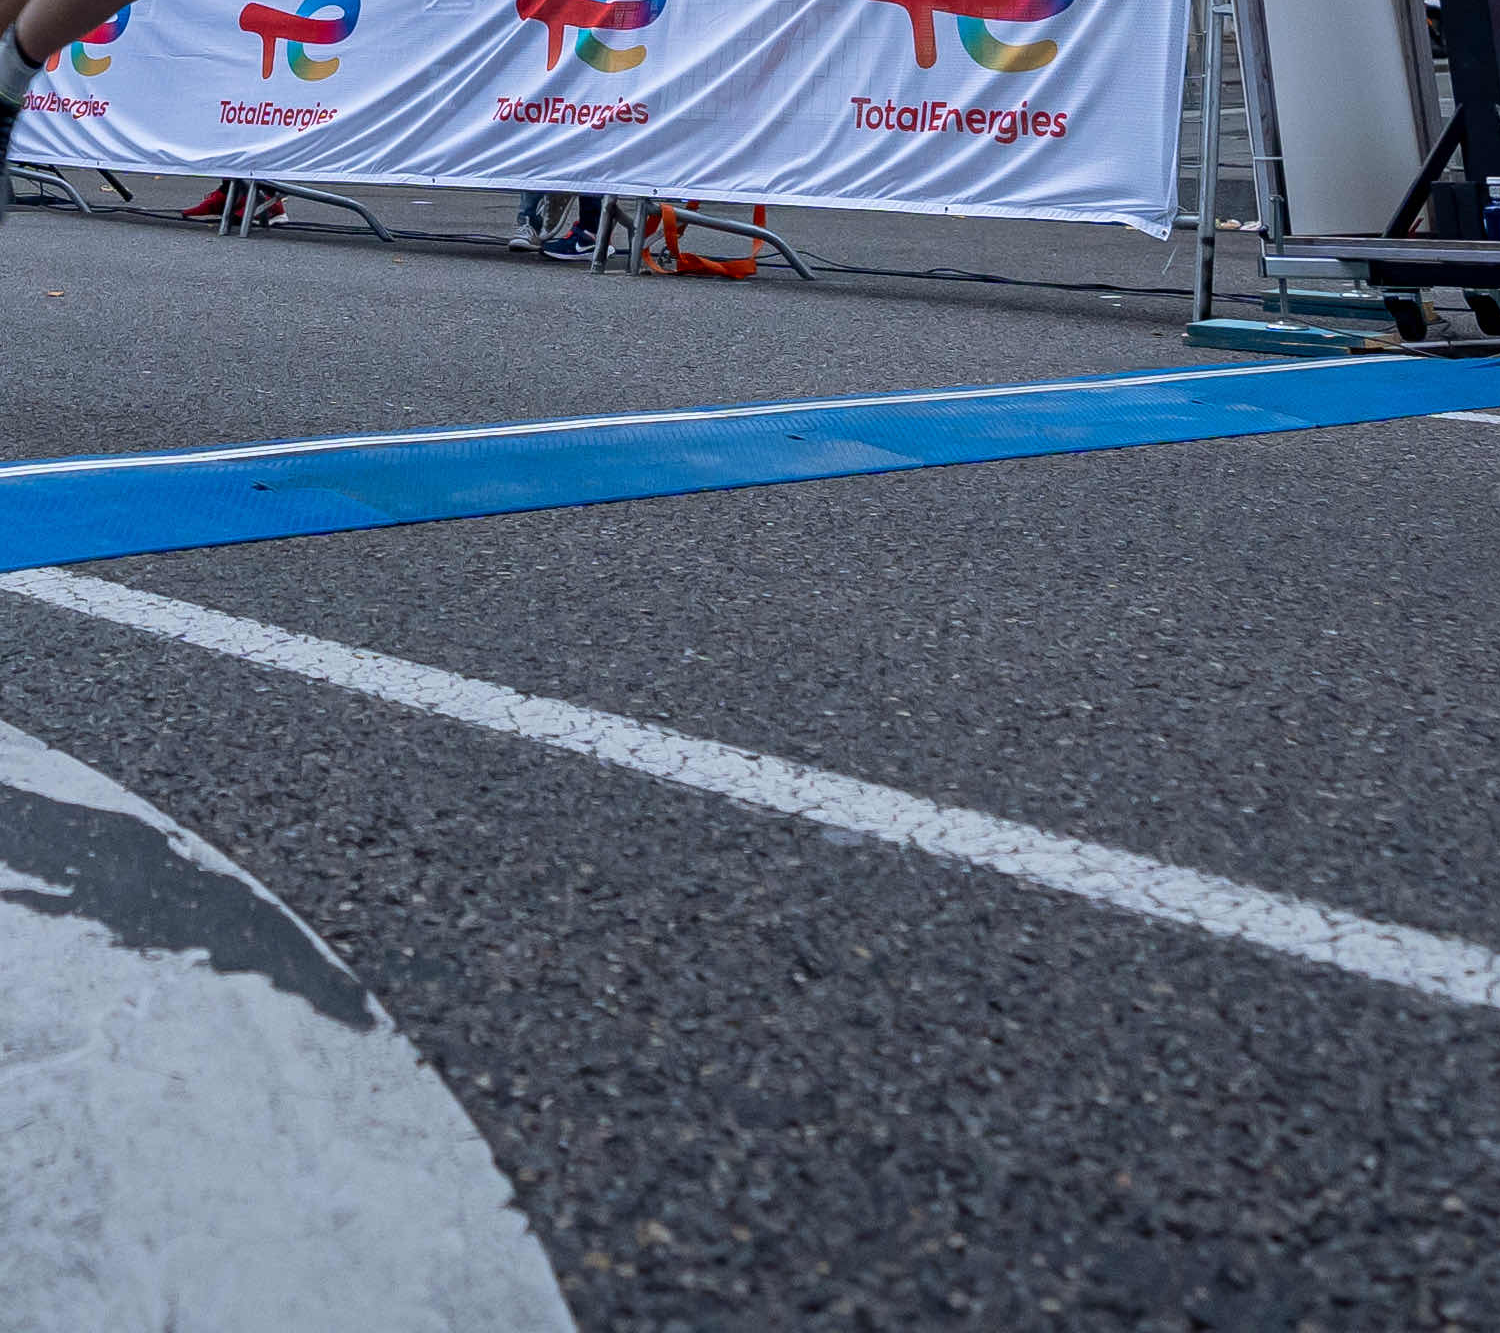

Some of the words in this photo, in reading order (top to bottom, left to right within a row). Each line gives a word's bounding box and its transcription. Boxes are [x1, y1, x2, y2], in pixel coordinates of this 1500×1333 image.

[219, 99, 338, 132] TotalEnergies
[492, 96, 649, 129] TotalEnergies
[851, 96, 1067, 144] TotalEnergies
